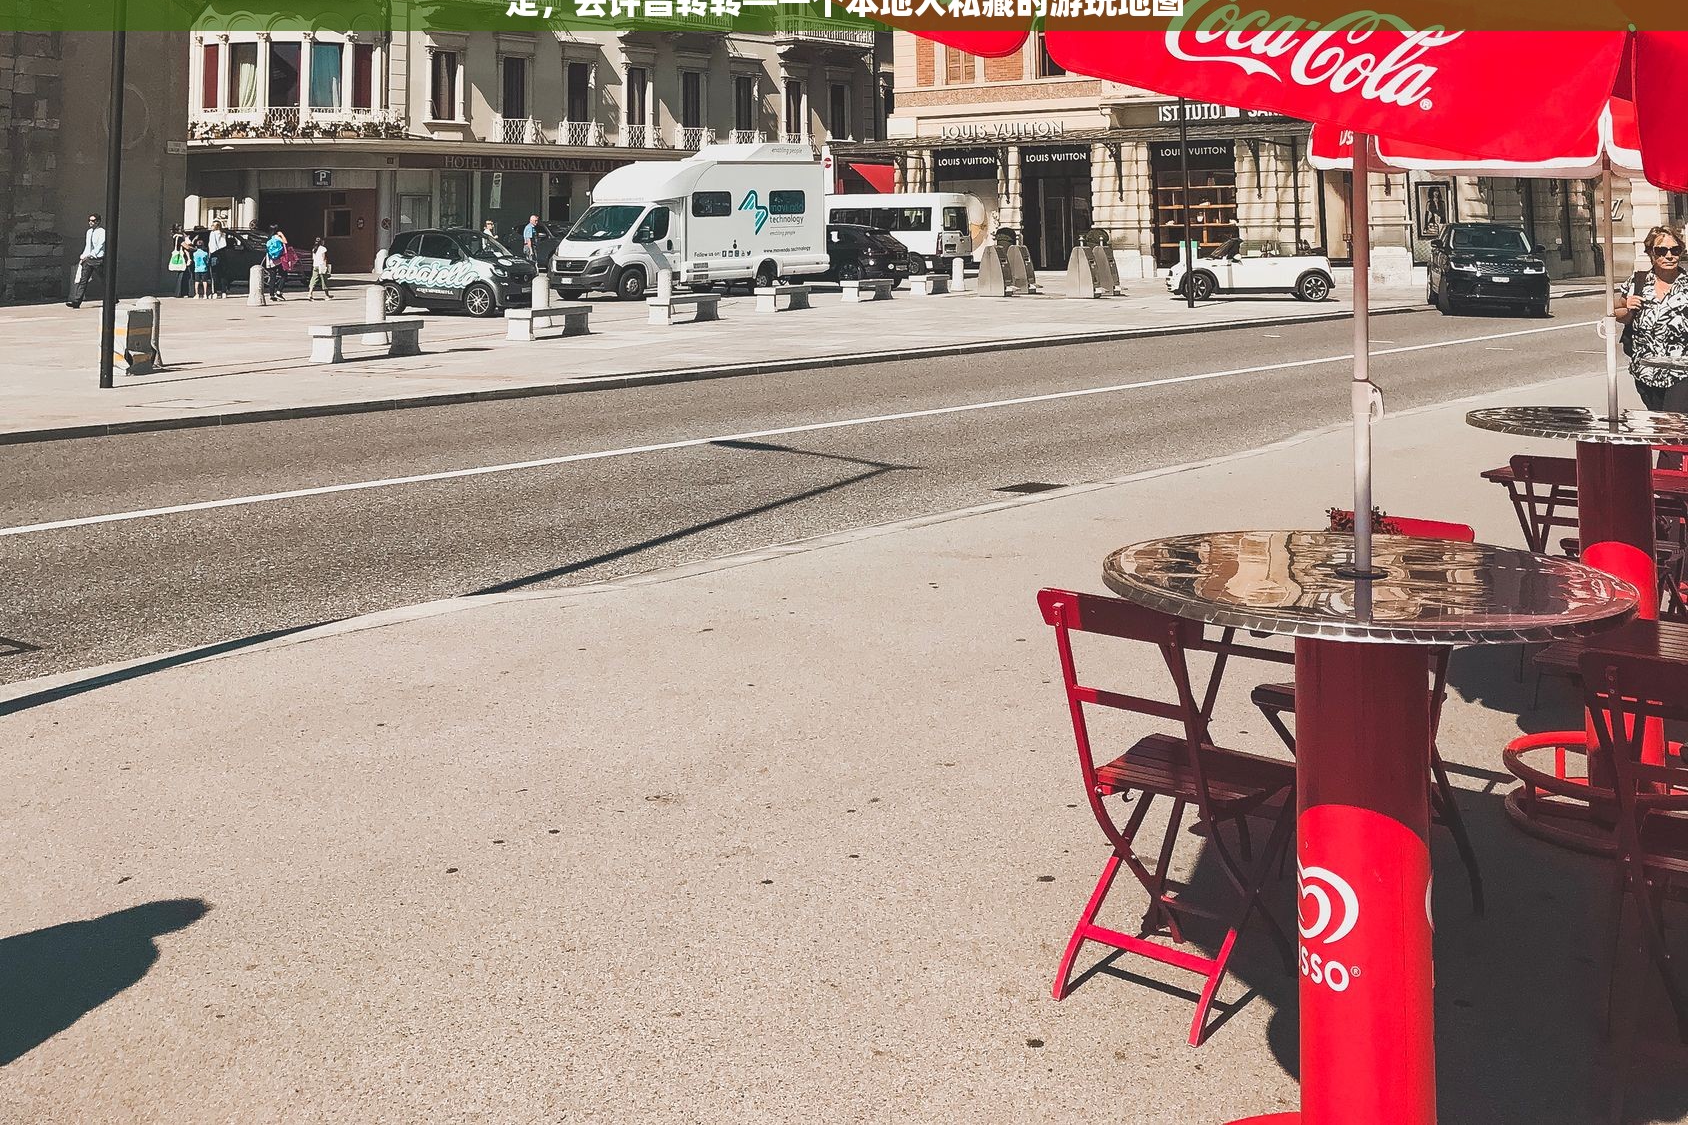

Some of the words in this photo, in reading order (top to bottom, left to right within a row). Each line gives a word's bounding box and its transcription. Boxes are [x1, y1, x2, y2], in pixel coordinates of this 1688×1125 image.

[1158, 103, 1221, 122] ISTTUTO
[940, 125, 988, 139] LOUIS
[993, 121, 1065, 137] VUITTON
[1160, 148, 1182, 157] LOUI
[1188, 146, 1227, 155] VUITTON
[938, 158, 961, 167] LOUIS
[961, 156, 995, 166] VUITTON
[1025, 154, 1050, 163] LOUIS
[1051, 152, 1087, 161] VUITTON
[769, 214, 805, 225] technology
[1299, 941, 1350, 992] SSO
